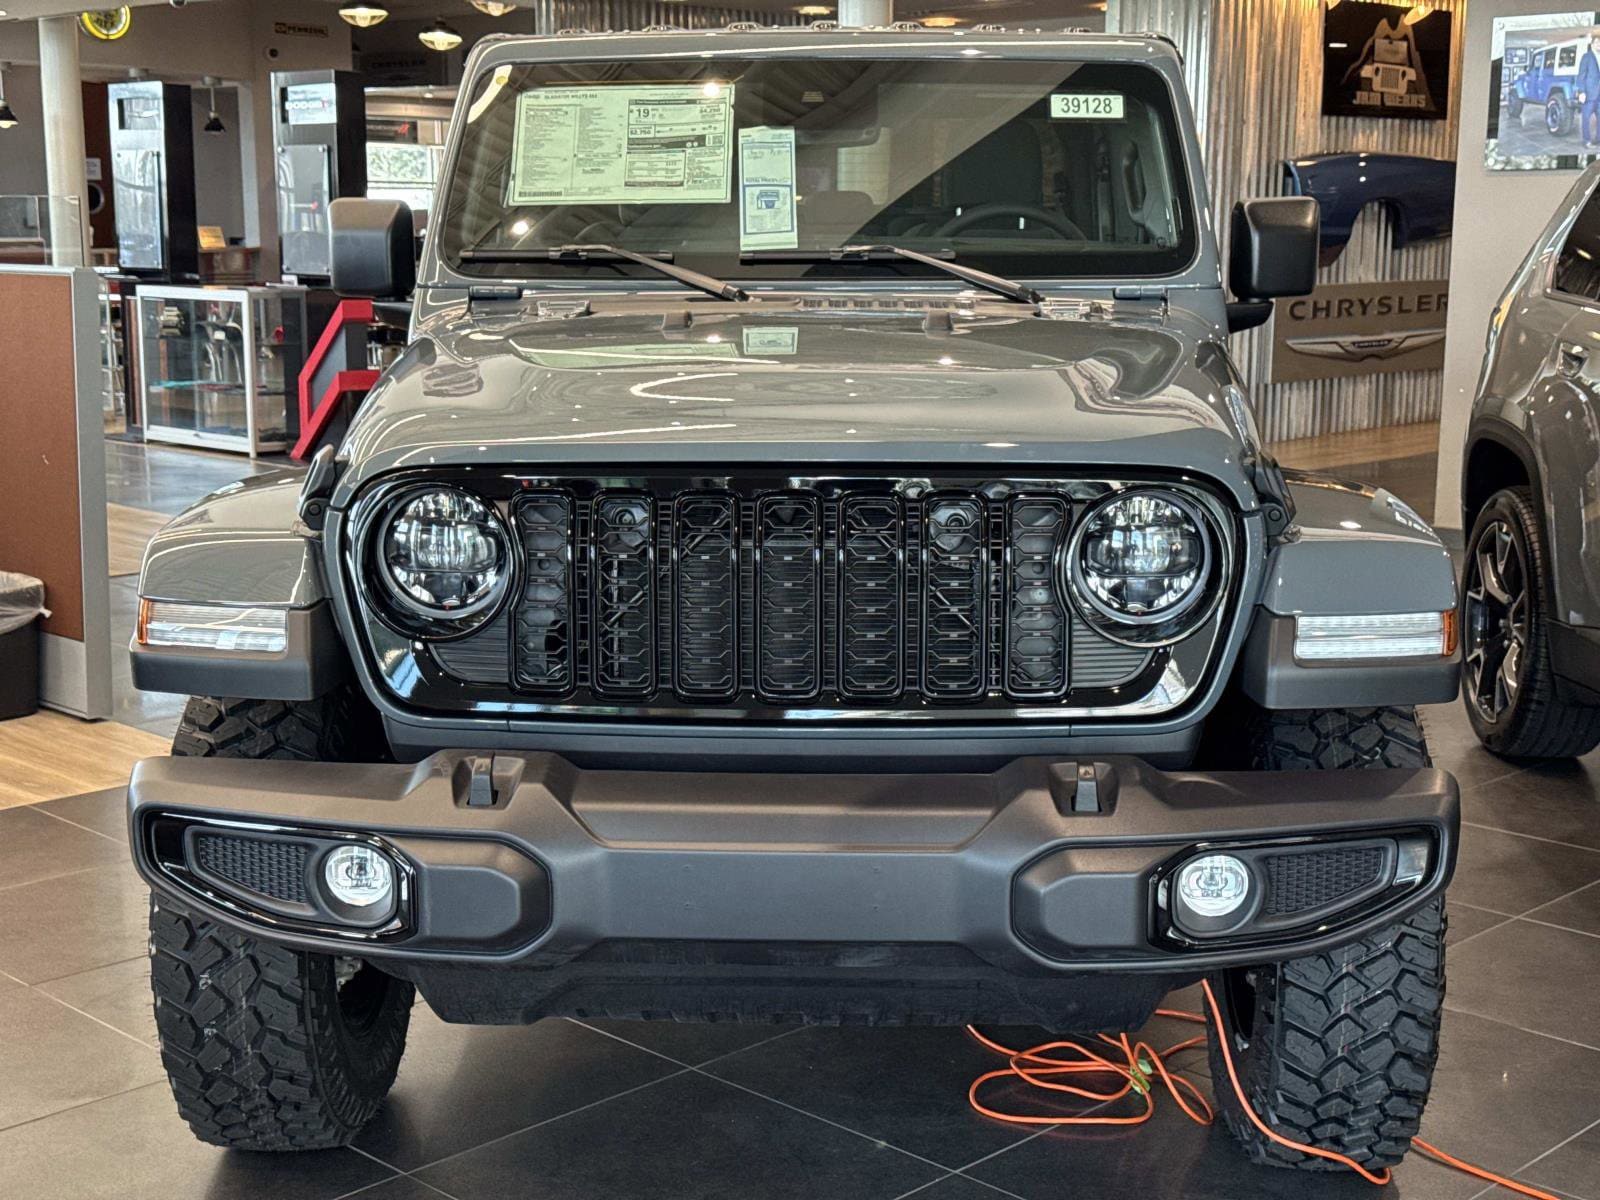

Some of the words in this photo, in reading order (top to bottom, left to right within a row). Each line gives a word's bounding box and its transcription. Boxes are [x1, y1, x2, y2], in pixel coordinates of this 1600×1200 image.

[635, 108, 650, 118] 19
[1061, 97, 1112, 114] 39128
[1289, 294, 1448, 320] CHRYSLER
